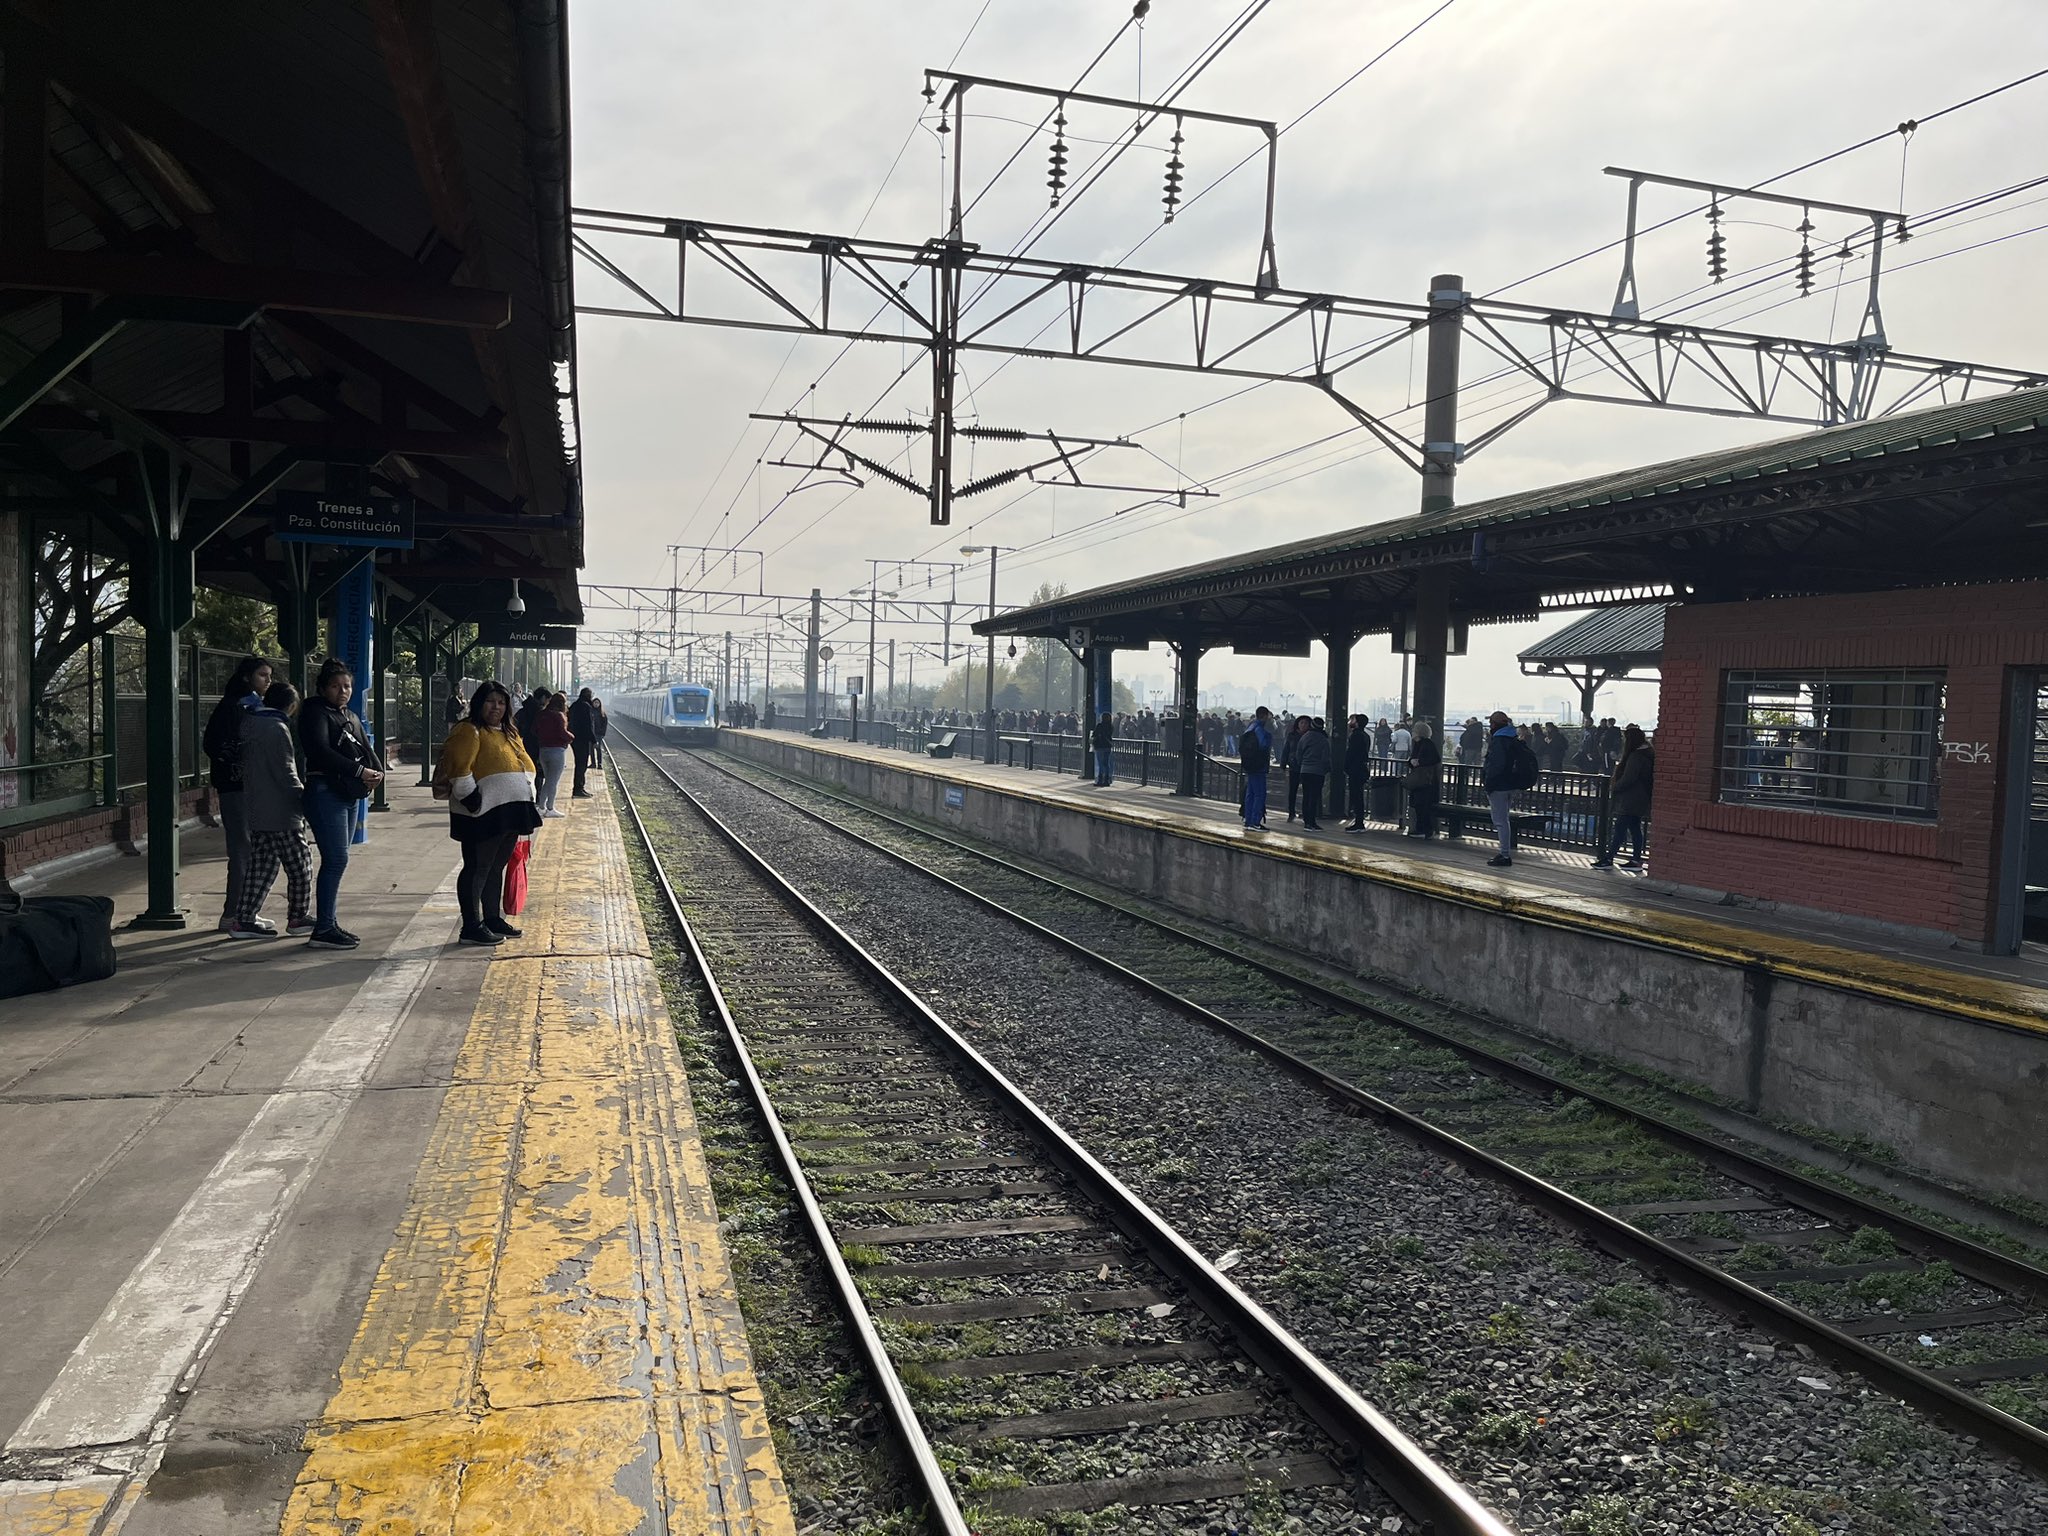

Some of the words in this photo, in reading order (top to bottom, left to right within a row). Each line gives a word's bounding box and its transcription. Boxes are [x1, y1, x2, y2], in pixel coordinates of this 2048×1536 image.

[317, 501, 363, 515] Trenes
[365, 507, 374, 516] a
[289, 514, 316, 528] Pza.
[320, 517, 401, 533] Constitución
[509, 632, 538, 641] Andén
[540, 633, 546, 641] 4
[1075, 630, 1084, 645] 3
